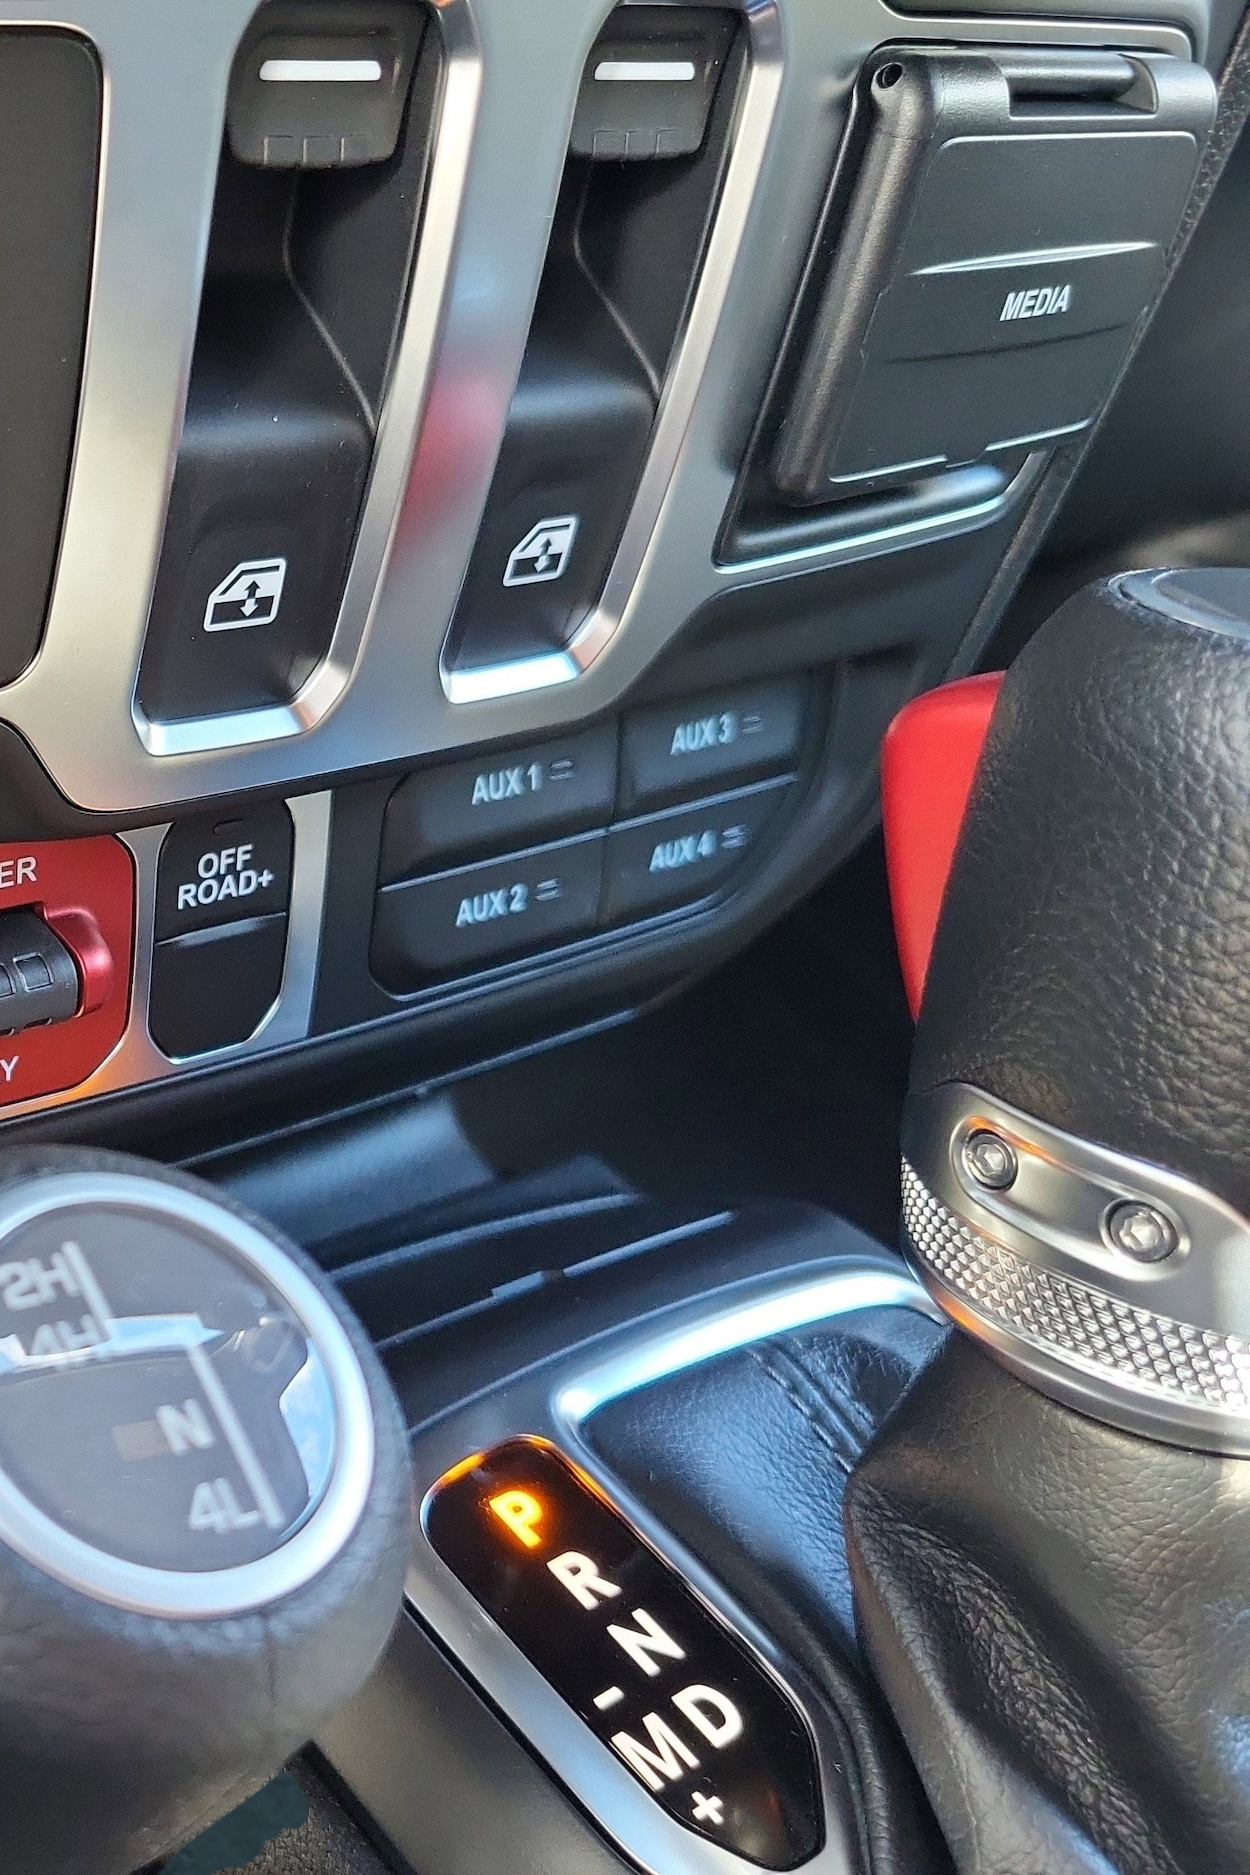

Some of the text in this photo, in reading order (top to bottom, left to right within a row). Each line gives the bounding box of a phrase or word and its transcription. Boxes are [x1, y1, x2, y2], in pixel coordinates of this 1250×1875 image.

[999, 284, 1072, 322] MEDIA
[670, 710, 738, 756] AUX 3
[471, 761, 543, 806] AUX 1
[197, 843, 255, 879] OFF
[649, 829, 719, 873] AUX 4
[177, 869, 275, 910] ROAD+
[455, 882, 530, 928] AUX 2
[156, 1398, 216, 1456] N
[188, 1477, 261, 1534] 4L
[488, 1490, 543, 1548] P
[546, 1550, 623, 1611] R
[606, 1607, 686, 1677] N
[670, 1684, 744, 1750] D
